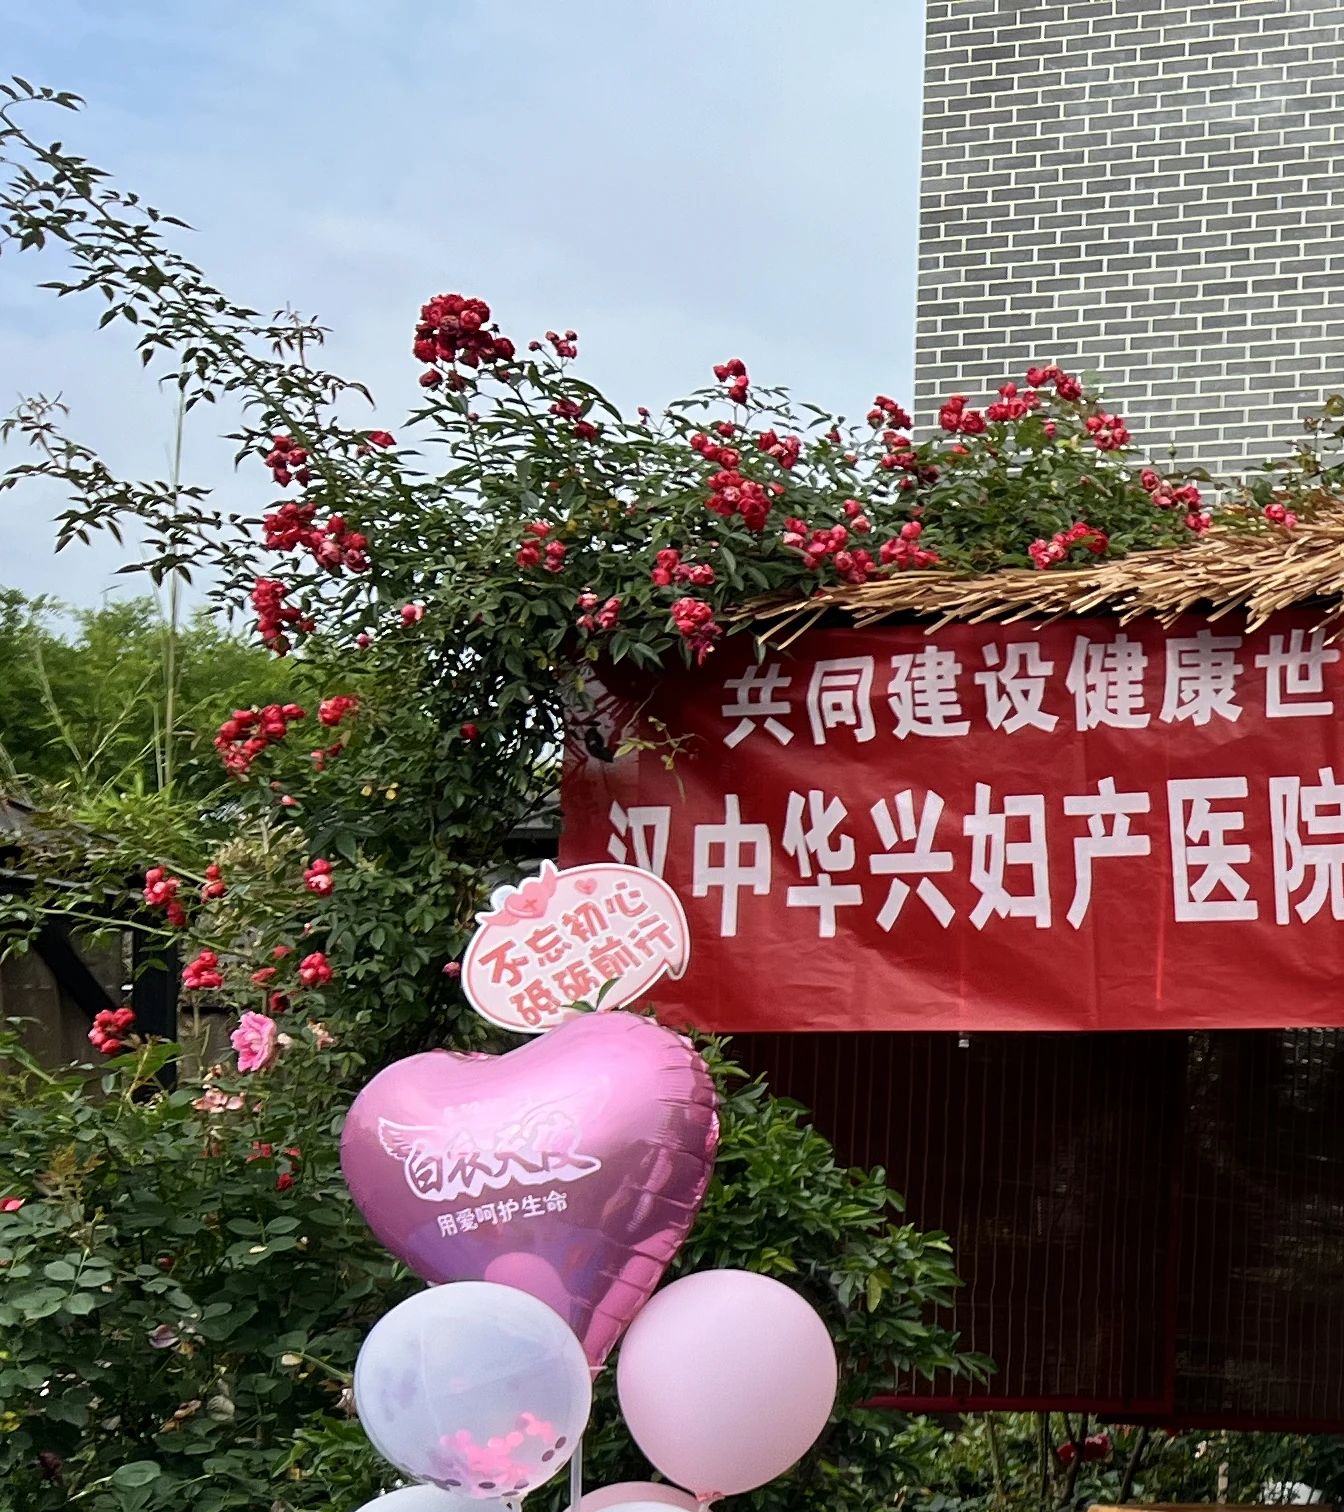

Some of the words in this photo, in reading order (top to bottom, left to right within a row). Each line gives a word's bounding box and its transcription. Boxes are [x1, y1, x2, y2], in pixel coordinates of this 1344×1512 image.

[478, 882, 649, 988] 不忘初心
[509, 914, 676, 1026] 砥砺前行
[436, 1190, 568, 1238] 用爱呵护生命
